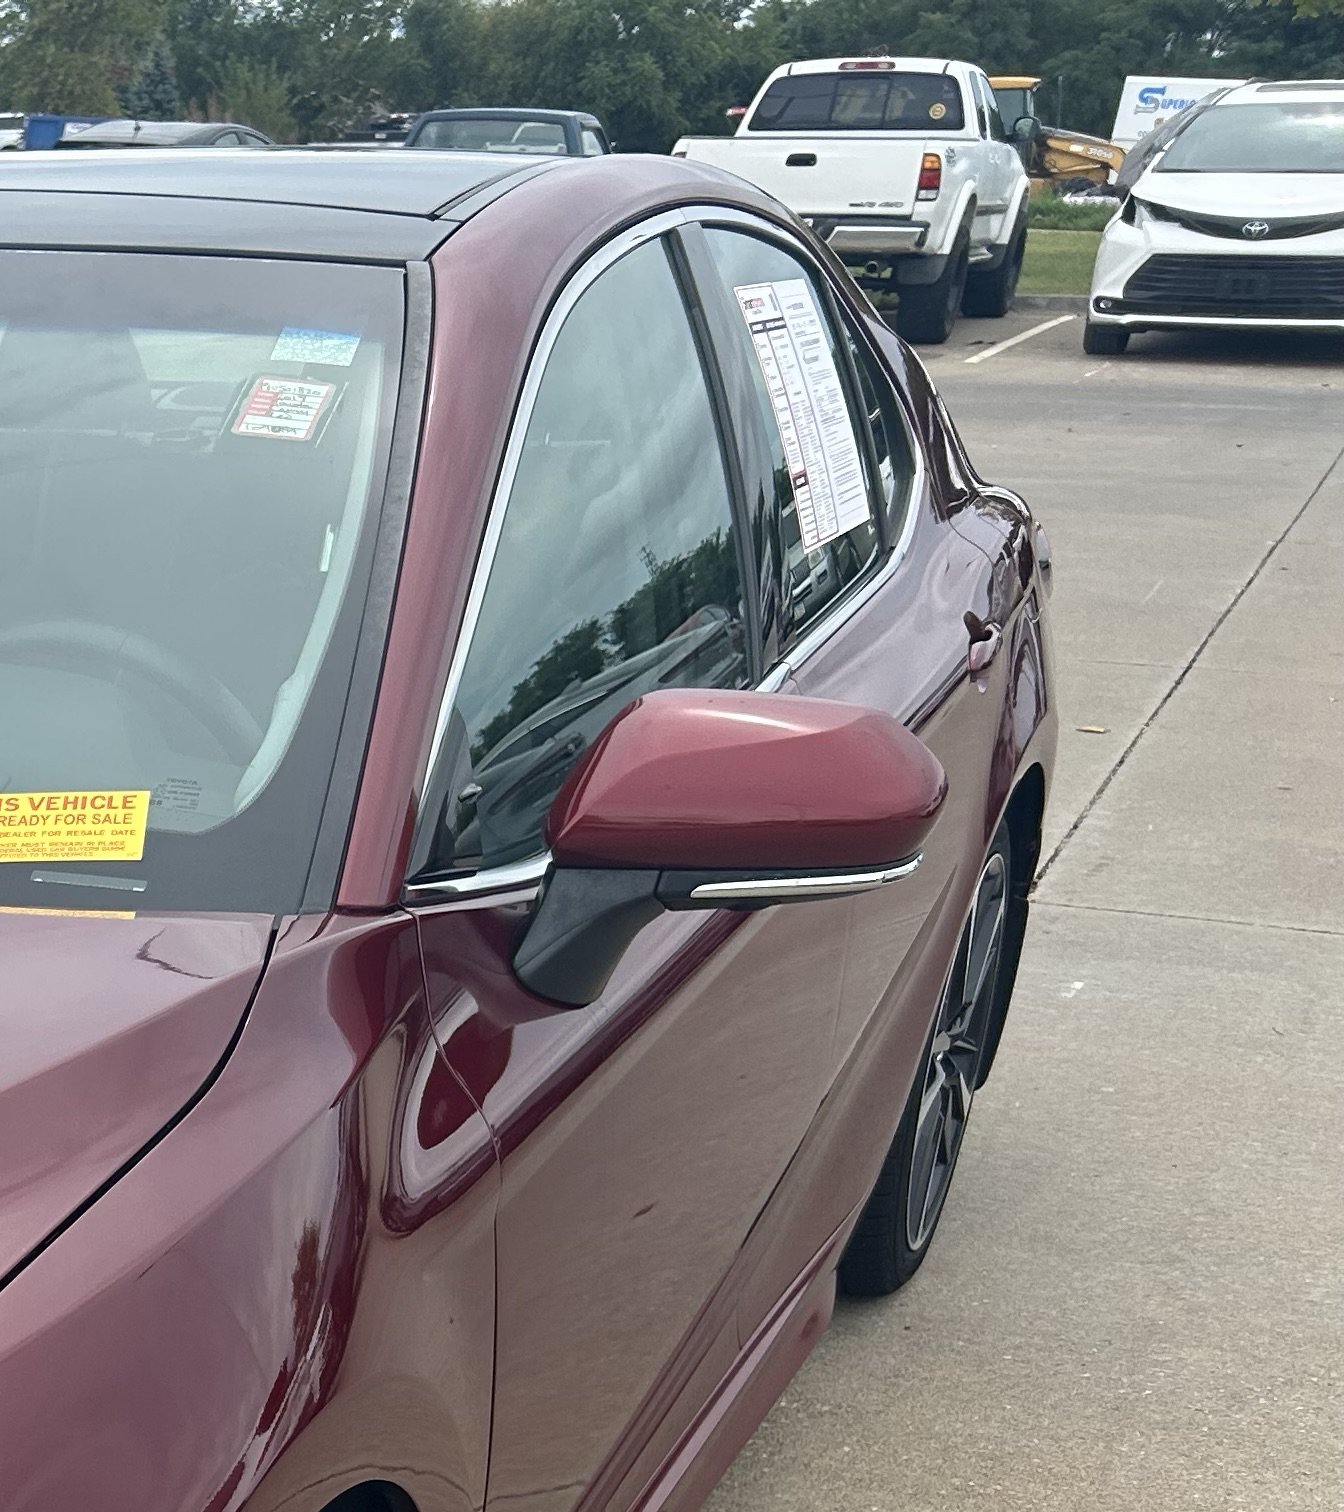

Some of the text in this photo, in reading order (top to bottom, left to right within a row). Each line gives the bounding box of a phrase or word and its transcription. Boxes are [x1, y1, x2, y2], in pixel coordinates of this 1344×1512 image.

[27, 795, 138, 811] VEHICLE
[54, 814, 87, 826] FOR
[91, 813, 133, 825] SALE
